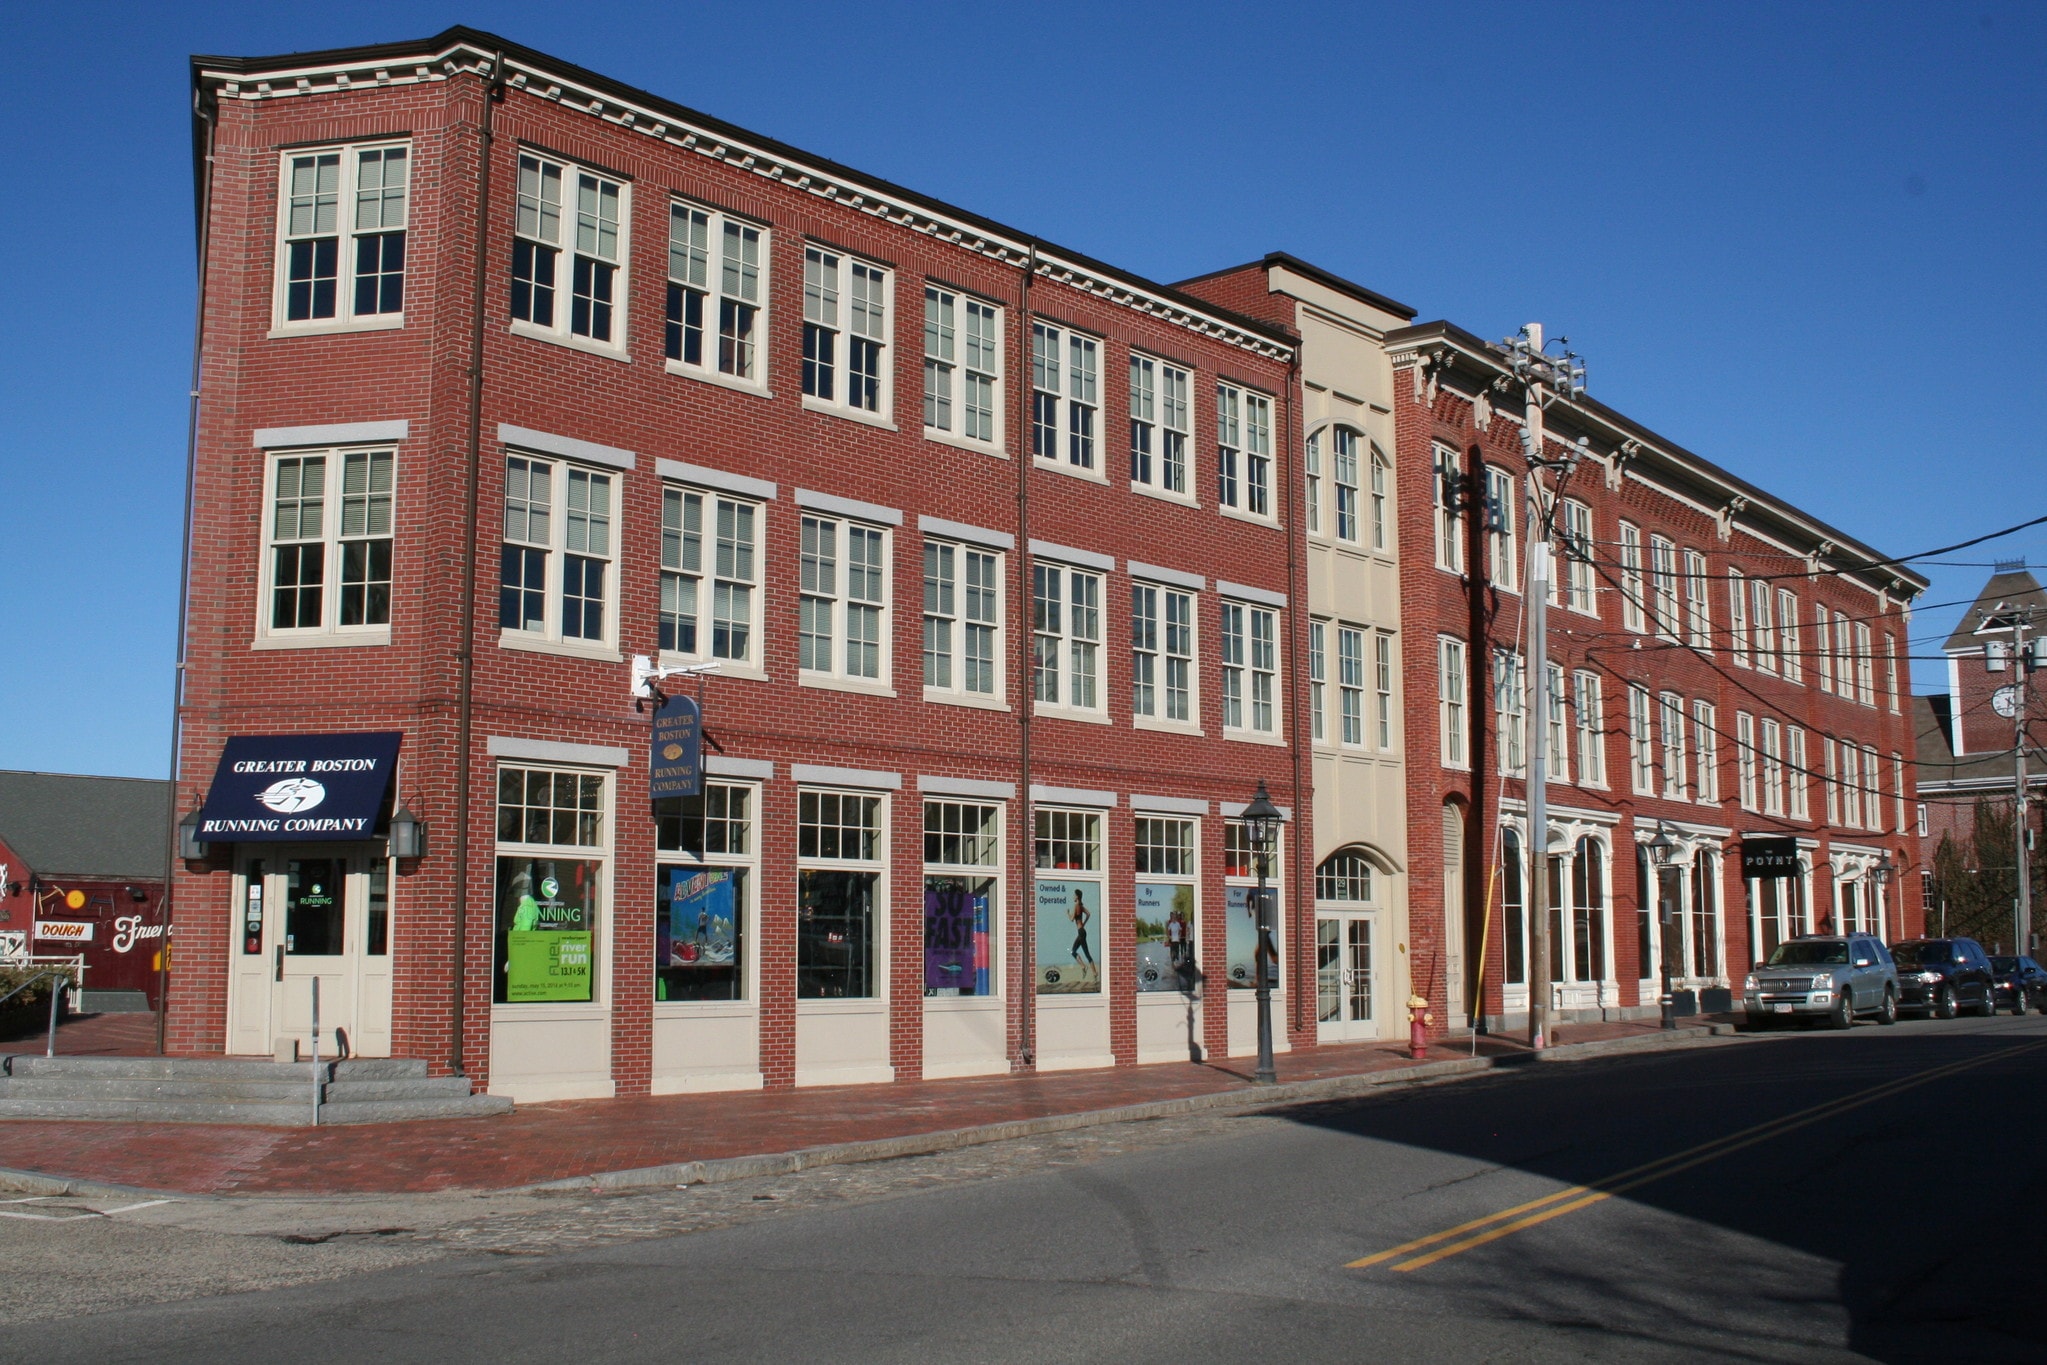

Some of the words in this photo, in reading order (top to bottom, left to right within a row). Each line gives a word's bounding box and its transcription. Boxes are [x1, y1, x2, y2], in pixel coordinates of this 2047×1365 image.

[656, 714, 694, 728] GREATER
[658, 729, 691, 742] BOSTON
[233, 760, 307, 773] GREATER
[311, 758, 378, 772] BOSTON
[654, 765, 692, 778] RUNNING
[653, 779, 693, 792] COMPANY
[202, 819, 280, 832] RUNNING
[284, 818, 368, 832] COMPANY
[1745, 856, 1793, 866] POYNT
[1039, 884, 1061, 893] Owned
[1061, 885, 1066, 893] &
[1337, 879, 1346, 888] 29
[1145, 887, 1153, 897] By
[1233, 889, 1242, 897] For
[300, 897, 332, 905] RUNNING
[934, 892, 963, 917] SO
[1038, 896, 1067, 905] Operated
[1138, 899, 1160, 907] Runners
[538, 907, 581, 922] NNING
[41, 923, 85, 937] DOUGH
[925, 917, 974, 950] FAST
[561, 940, 587, 952] river
[561, 953, 588, 965] run
[577, 967, 586, 976] 5K
